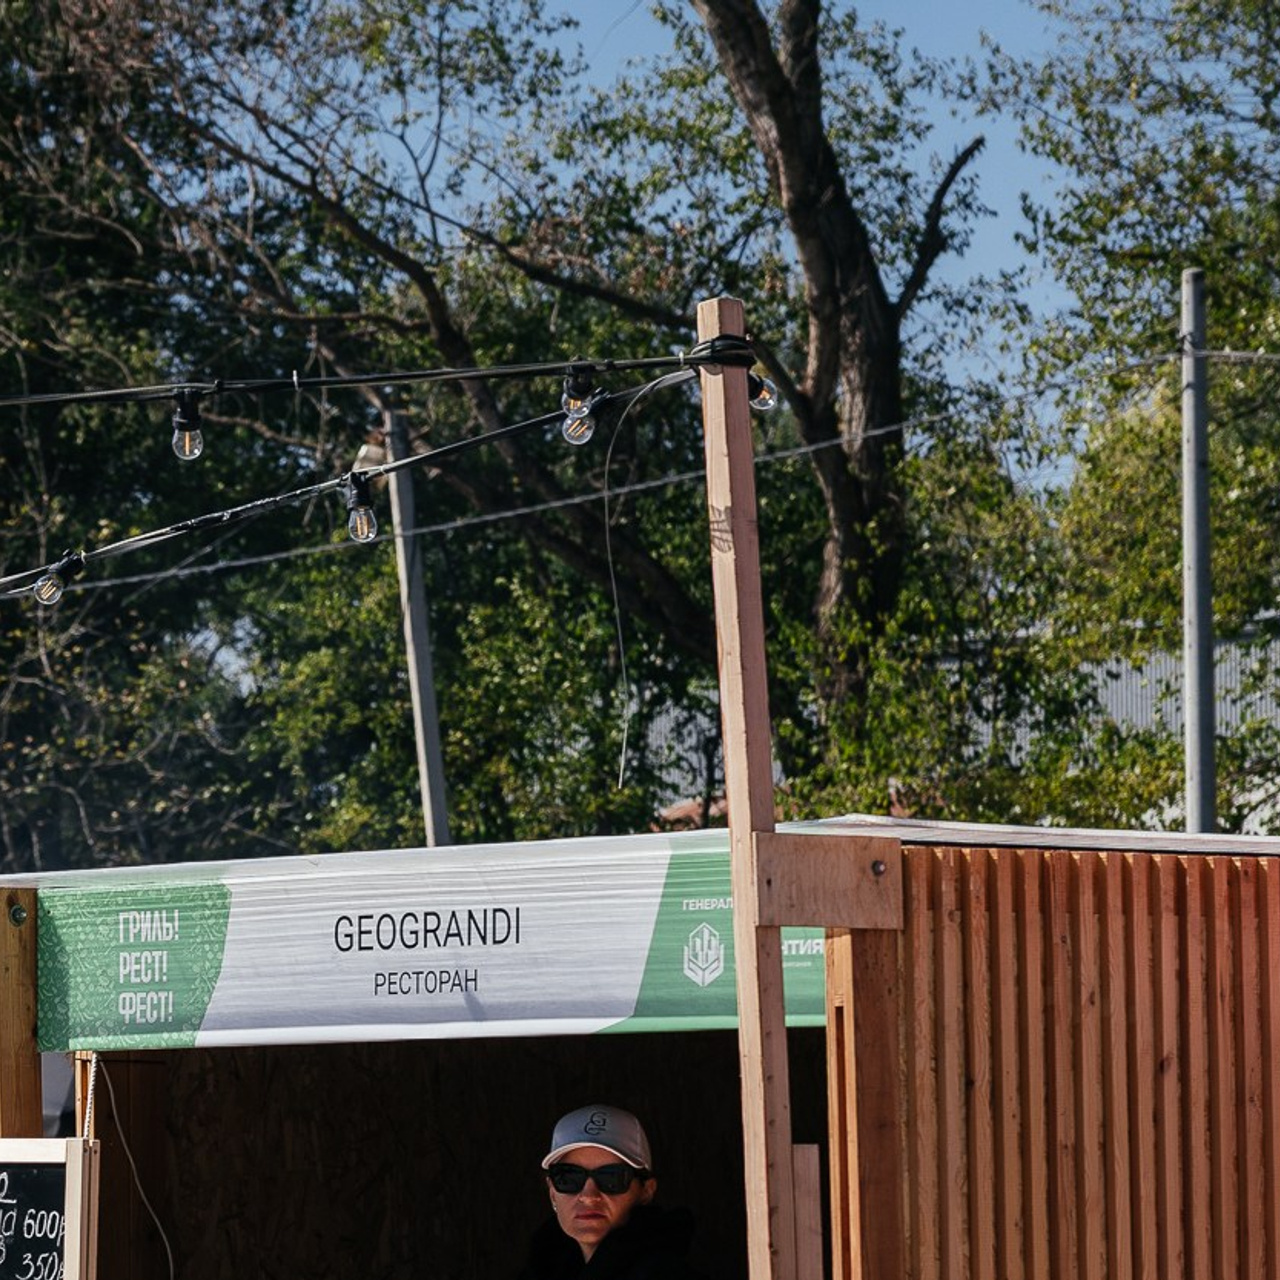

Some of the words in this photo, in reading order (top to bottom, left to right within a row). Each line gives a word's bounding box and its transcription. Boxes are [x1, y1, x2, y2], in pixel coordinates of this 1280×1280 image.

[119, 909, 179, 943] ГРИЛЬ!
[334, 906, 519, 952] GEOGRANDI
[119, 951, 169, 984] РЕСТ!
[375, 969, 478, 995] РЕСТОРАН
[119, 991, 174, 1024] ФЕСТ!
